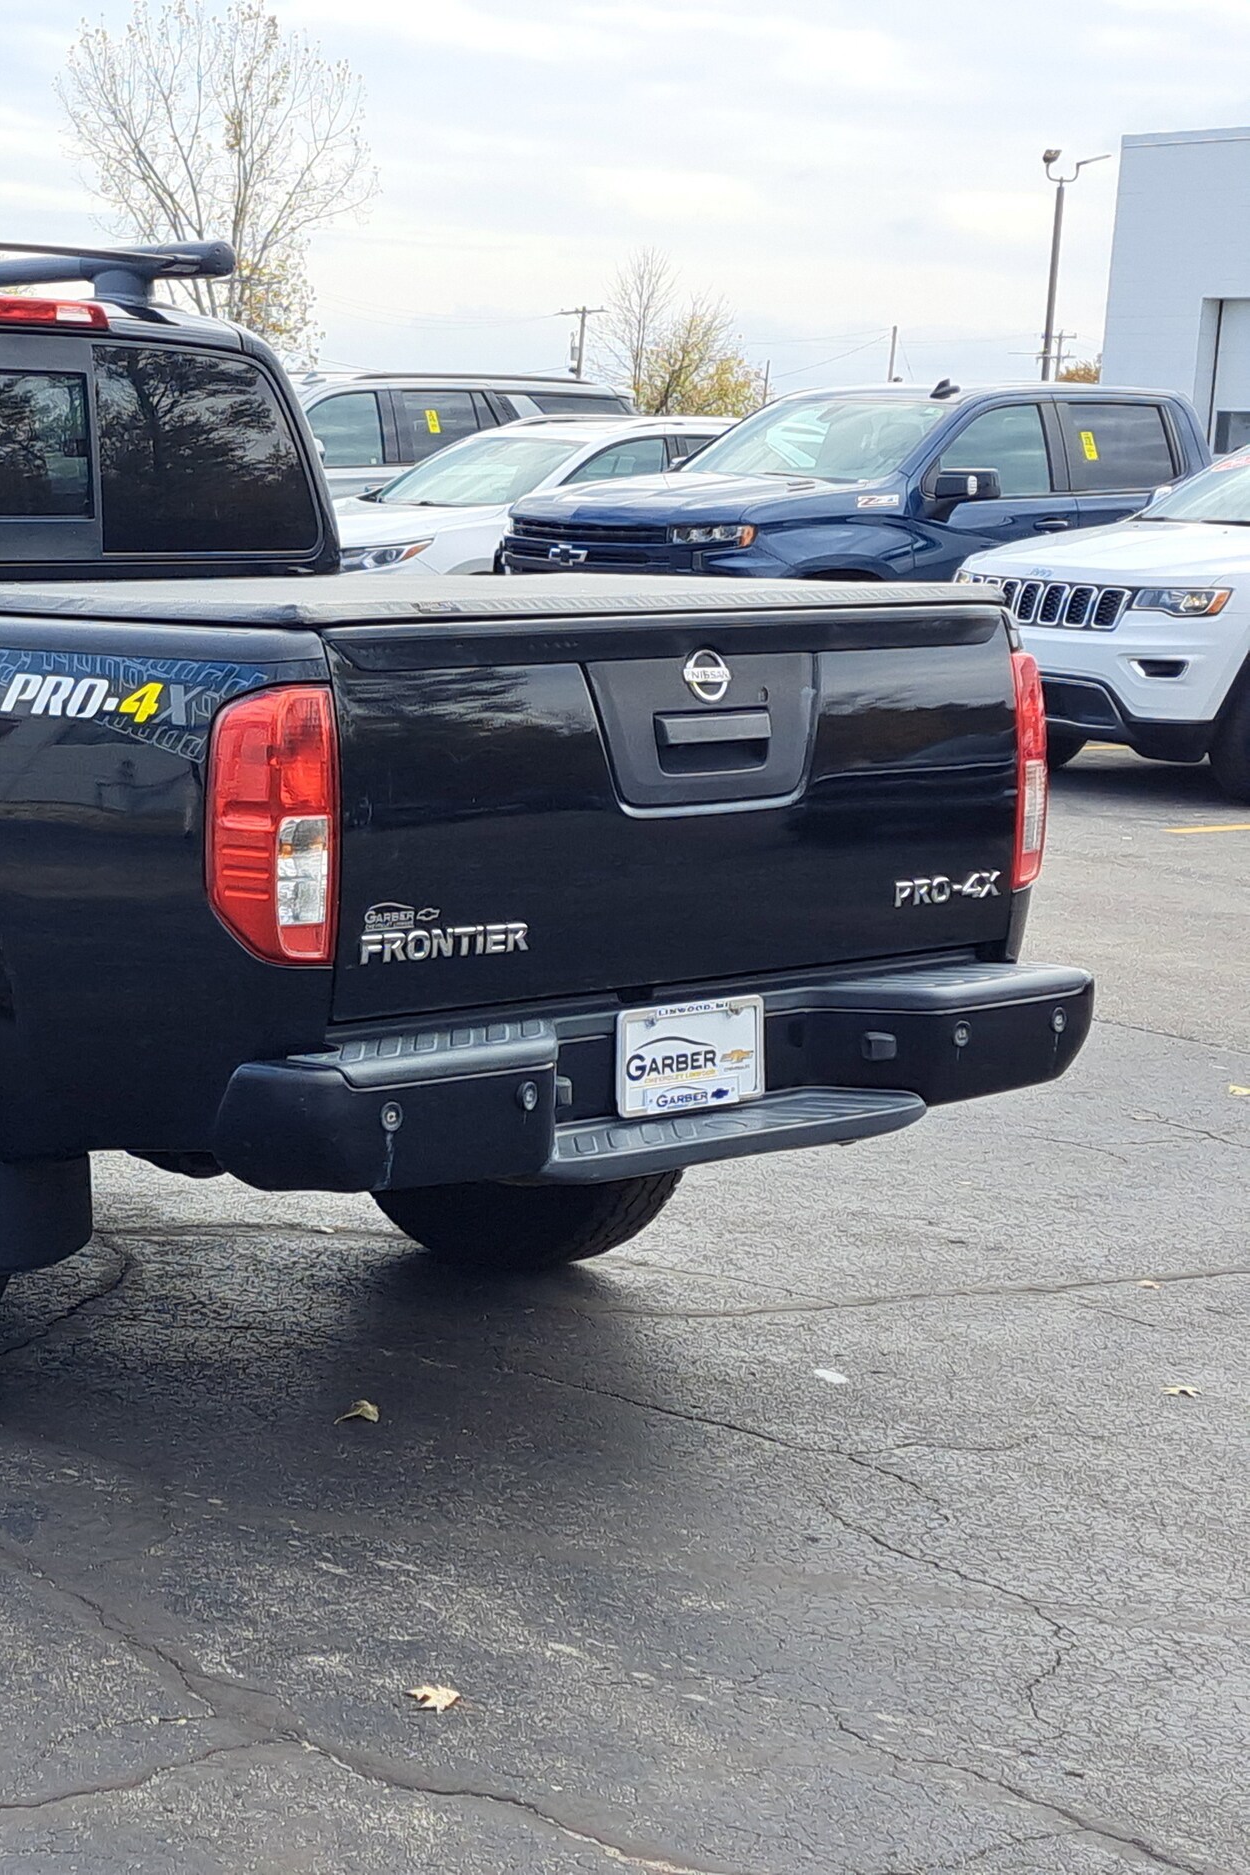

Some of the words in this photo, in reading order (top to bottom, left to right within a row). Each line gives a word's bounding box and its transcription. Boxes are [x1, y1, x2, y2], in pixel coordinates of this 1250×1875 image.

[691, 669, 729, 680] NISSAN
[0, 673, 197, 726] PRO-4X
[893, 869, 1002, 908] PRO-4X
[364, 910, 415, 924] GARBER
[359, 922, 529, 966] FRONTIER
[625, 1049, 717, 1081] GARBER
[656, 1091, 708, 1108] GARBER
